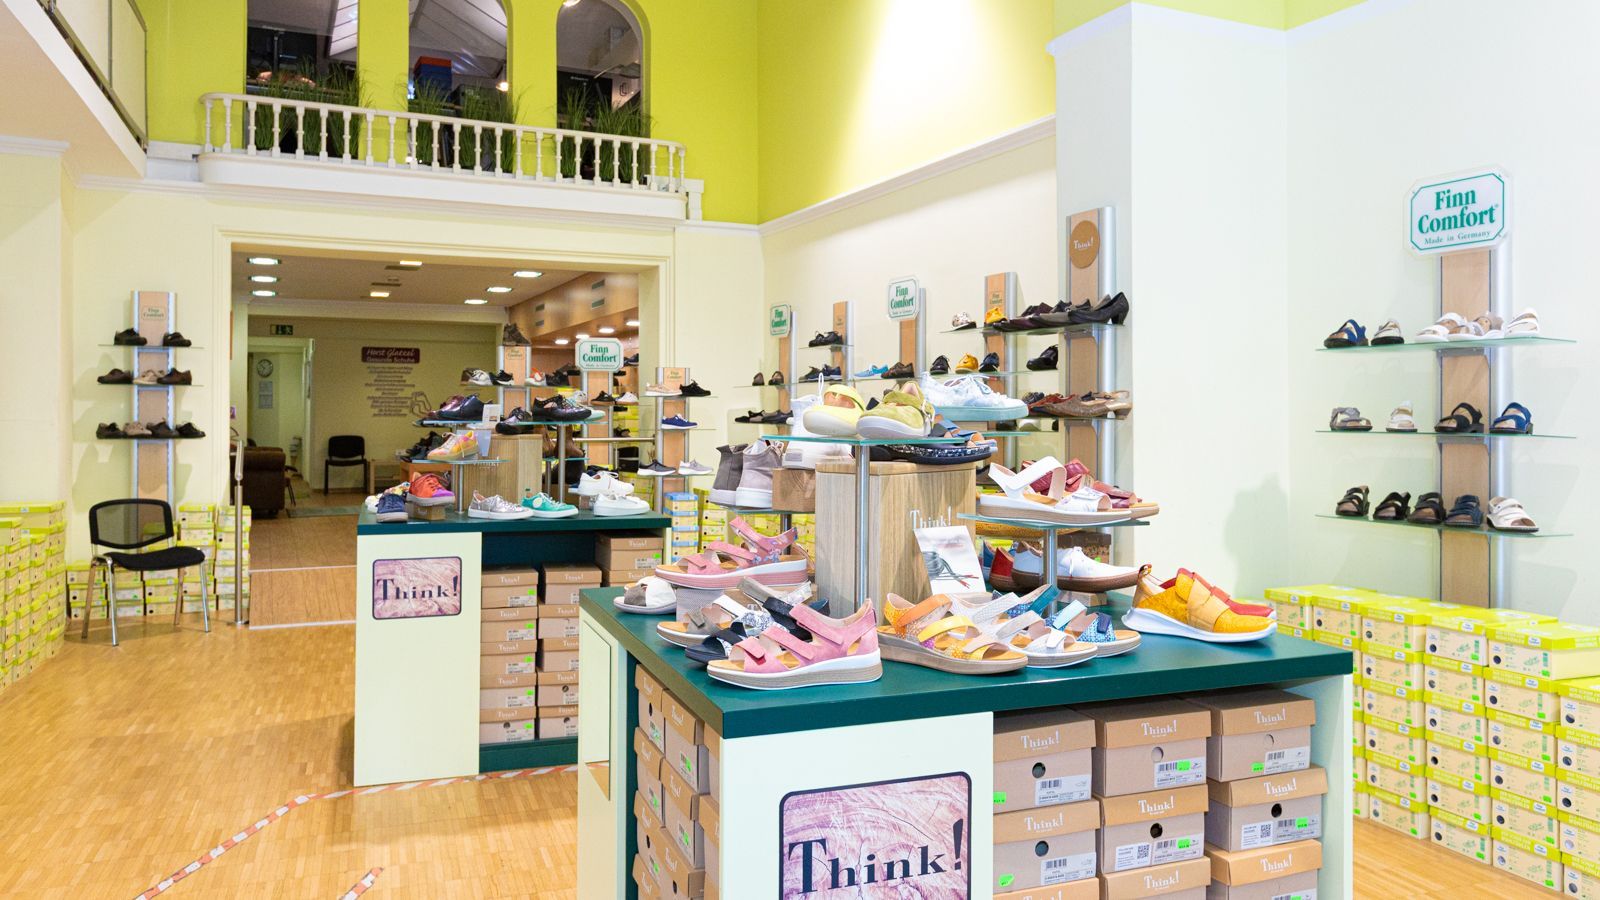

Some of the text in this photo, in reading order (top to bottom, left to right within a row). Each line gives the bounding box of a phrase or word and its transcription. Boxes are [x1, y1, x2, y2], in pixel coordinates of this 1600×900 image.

[1434, 189, 1476, 210] Finn
[1074, 236, 1094, 249] Think!
[1424, 236, 1443, 244] Made
[1458, 231, 1490, 240] Germany
[896, 286, 908, 296] Finn
[890, 296, 914, 309] Comfort
[582, 353, 616, 362] Comfort
[590, 344, 608, 353] Finn
[910, 506, 952, 529] Think!
[376, 575, 458, 600] Think!
[1254, 706, 1286, 724] Think!
[1141, 719, 1177, 736] Think!
[1021, 729, 1060, 749] Think!
[1264, 778, 1296, 795] Think!
[1138, 795, 1174, 813] Think!
[1024, 812, 1063, 831] Think!
[788, 818, 964, 894] Think!
[1260, 853, 1292, 872] Think!
[1144, 870, 1179, 889] Think!
